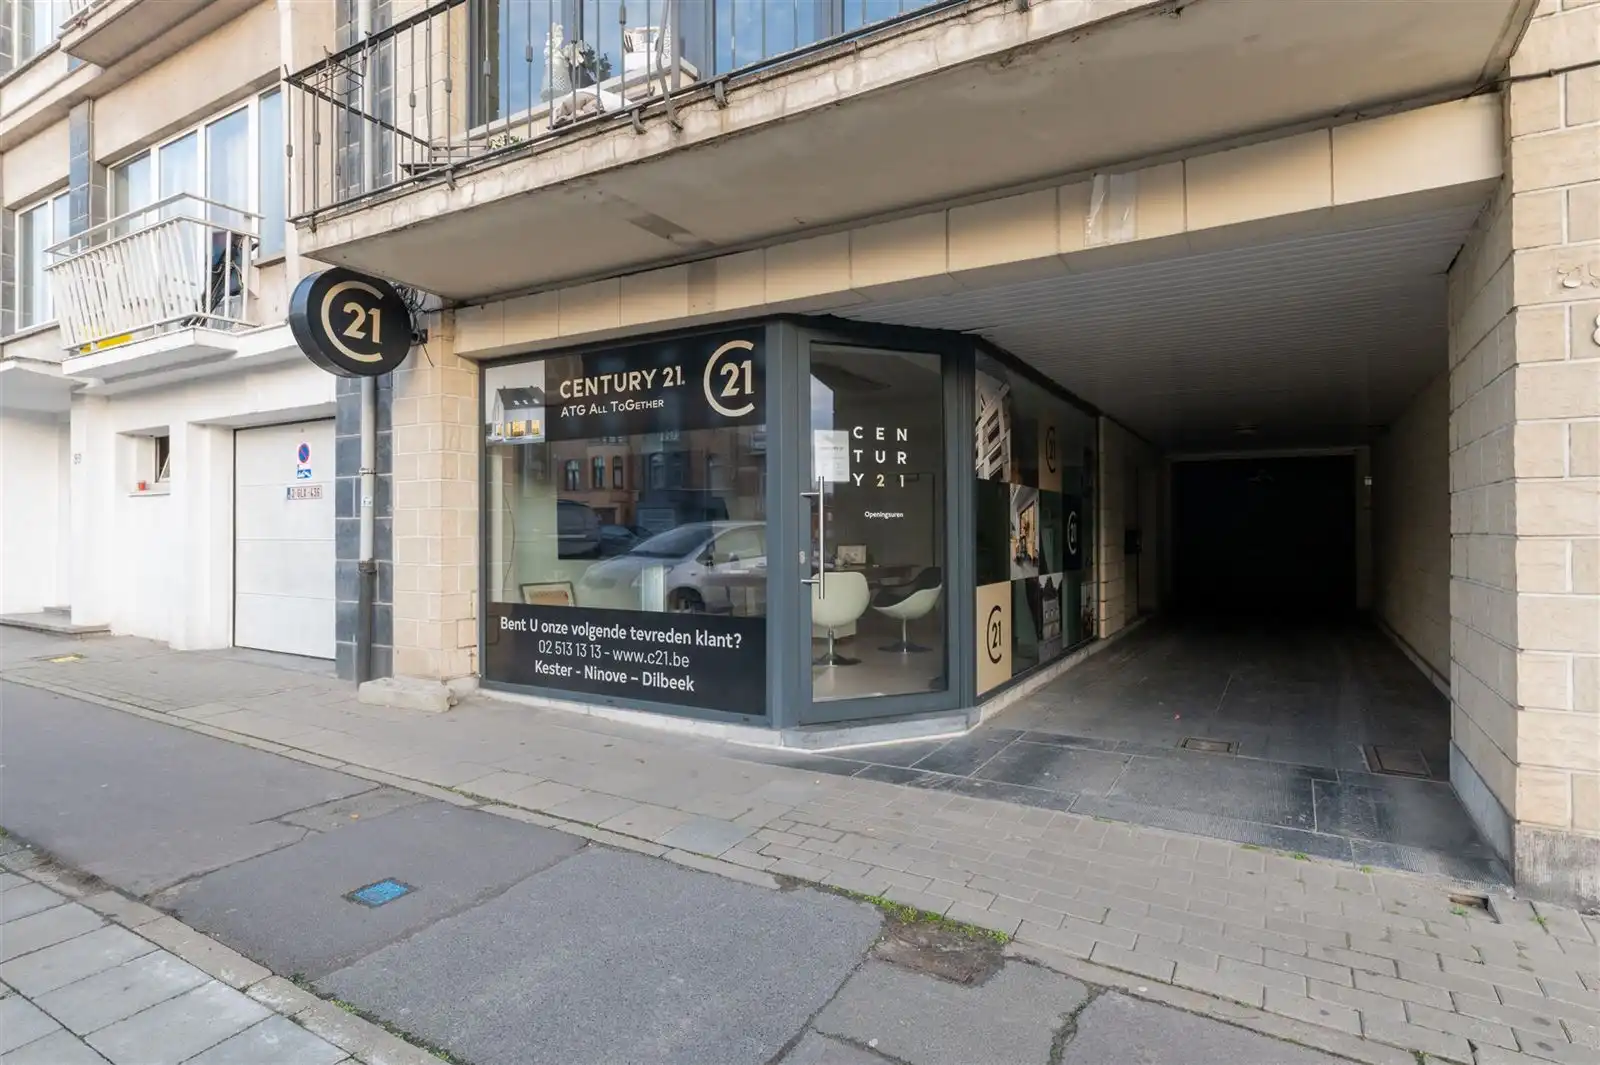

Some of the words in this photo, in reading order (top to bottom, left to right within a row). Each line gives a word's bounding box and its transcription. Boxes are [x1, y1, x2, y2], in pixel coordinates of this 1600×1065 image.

[559, 368, 656, 399] CENTURY
[560, 404, 586, 418] ATG
[864, 510, 904, 520] Openingsuren
[500, 616, 527, 632] Bent
[529, 618, 539, 633] U
[541, 621, 569, 635] onze
[571, 621, 627, 642] volgende
[629, 626, 692, 646] tevreden
[695, 629, 742, 649] klant?
[538, 639, 553, 655] 02
[554, 640, 573, 656] 513
[575, 642, 587, 658] 13
[589, 643, 602, 659] 13
[612, 649, 690, 668] www.c21.be
[534, 659, 573, 677] Kester
[584, 664, 628, 684] Ninove
[642, 671, 695, 692] Dilbeek
